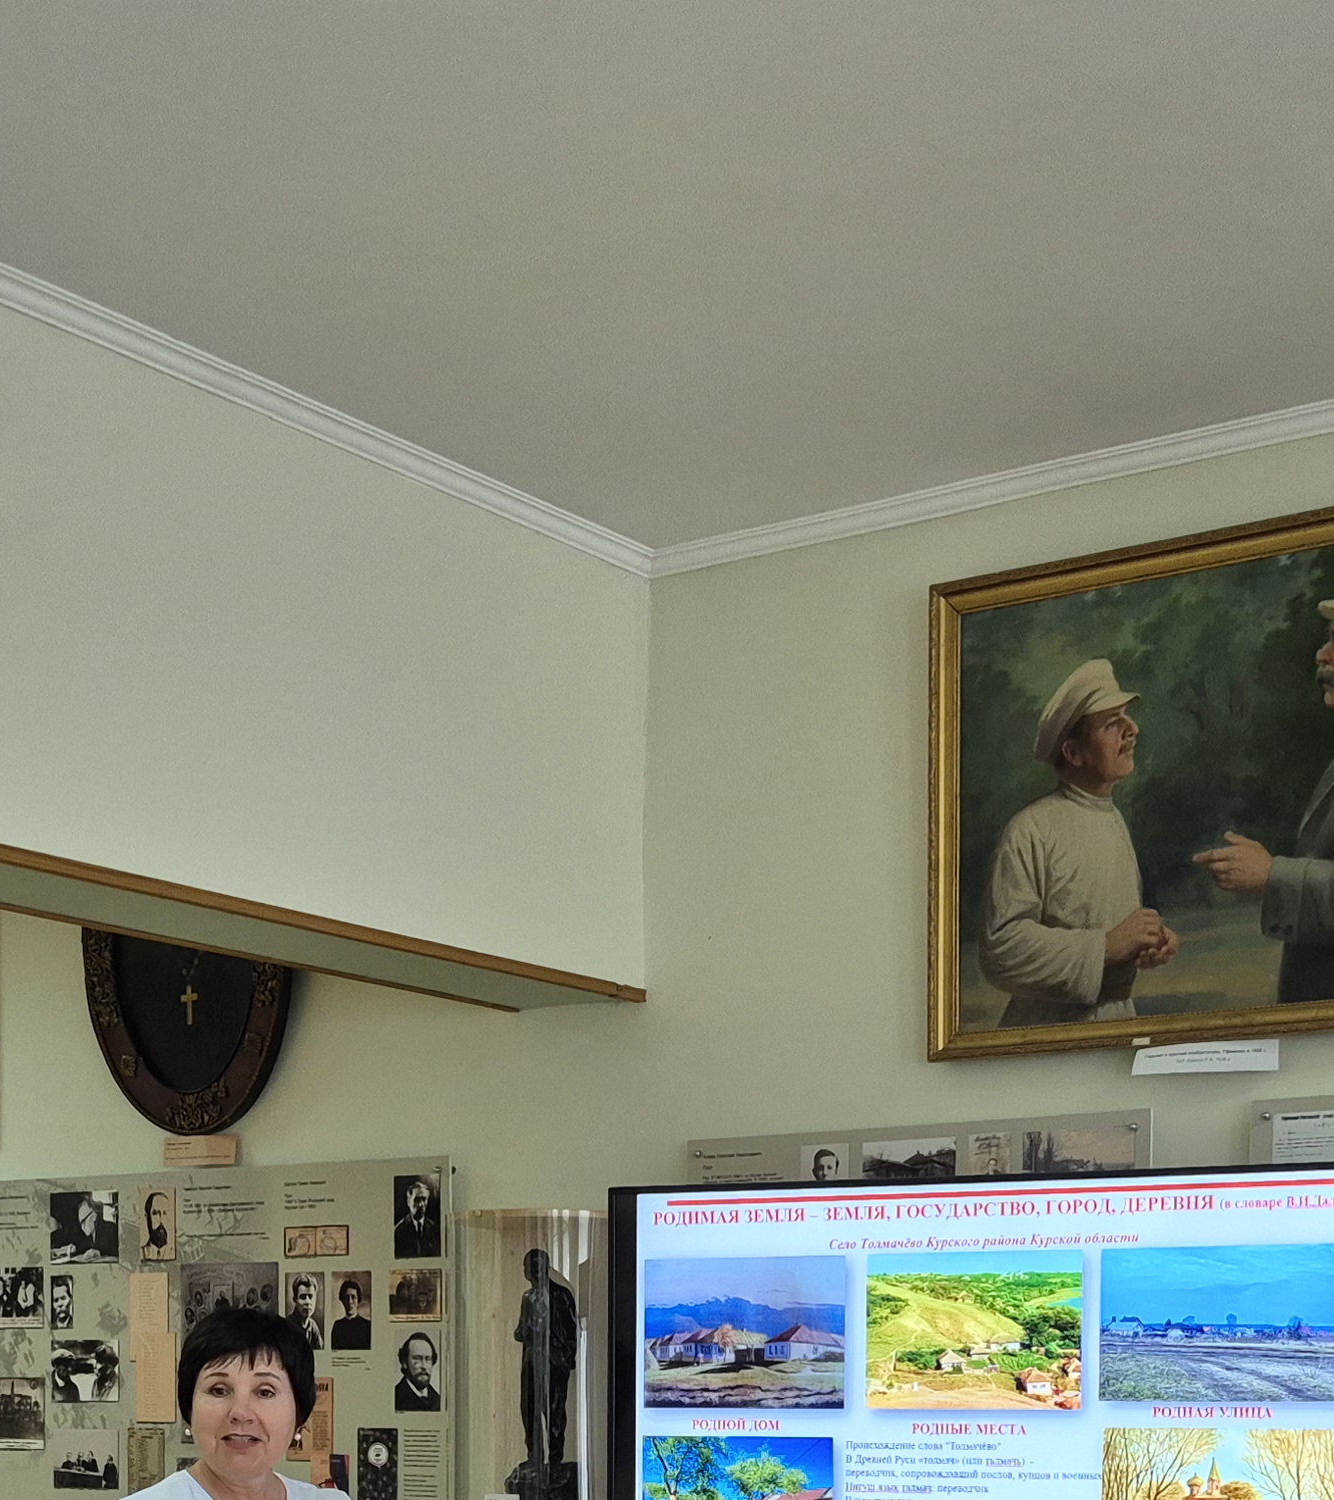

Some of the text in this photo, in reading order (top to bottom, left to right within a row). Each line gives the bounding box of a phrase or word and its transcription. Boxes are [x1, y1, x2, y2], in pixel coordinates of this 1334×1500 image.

[653, 1209, 740, 1227] РОДИМАЯ
[745, 1207, 806, 1224] ЗЕМЛЯ
[823, 1205, 891, 1222] ЗЕМЛЯ,
[896, 1200, 1042, 1221] ГОСУДАРСТВО,
[1046, 1199, 1117, 1217] ГОРОД,
[1120, 1195, 1214, 1216] ДЕРЕВНЯ
[1235, 1197, 1283, 1210] словаре
[829, 1231, 1139, 1251] Село Толмачёво Курского района Курской области
[1152, 1406, 1273, 1421] РОДНАЯ УЛИЦА
[691, 1418, 780, 1433] РОДНОЙ ДОМ
[911, 1423, 1027, 1436] РОДНЫЕ МЕСТА
[845, 1441, 915, 1452] Происхождение
[918, 1442, 943, 1451] слова
[845, 1455, 852, 1464] В
[854, 1455, 893, 1467] Древней
[895, 1455, 916, 1466] Руси
[962, 1456, 983, 1467] (или
[845, 1470, 898, 1480] переводчик,
[900, 1469, 978, 1480] сопровождавший
[981, 1471, 1015, 1481] послов,
[1018, 1472, 1051, 1482] купцов
[1053, 1472, 1059, 1480] и
[937, 1485, 989, 1496] переводчик
